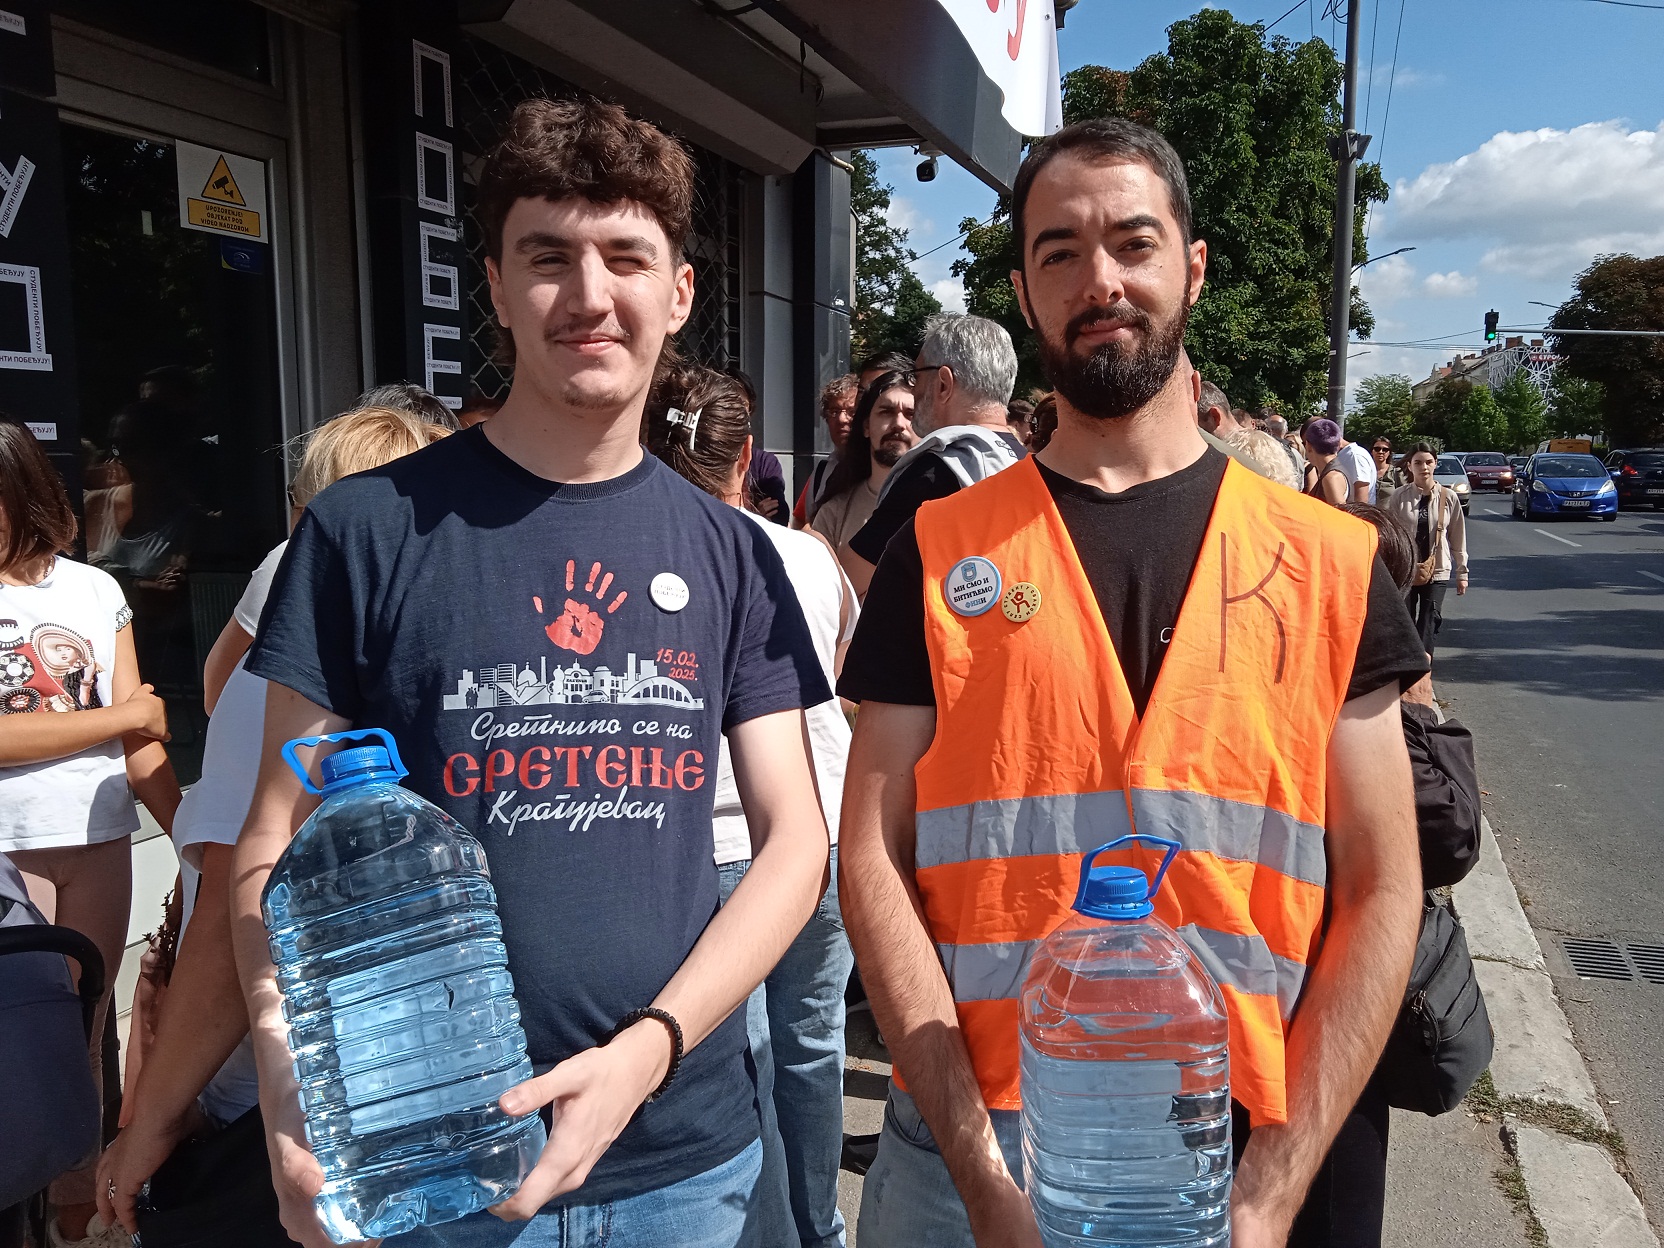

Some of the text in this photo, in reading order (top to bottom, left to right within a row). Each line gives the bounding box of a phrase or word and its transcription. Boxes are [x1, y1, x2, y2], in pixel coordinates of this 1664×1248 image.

[11, 160, 30, 199] ПОБЕЂУЈУ!
[205, 204, 243, 218] UPOZORENJE!
[206, 212, 231, 222] OBJEKAT
[200, 218, 250, 233] VIDEO NADZOROM
[30, 269, 42, 352] СТУДЕНТИ ПОБЕЂУЈУ!
[13, 356, 51, 365] ПОБЕЂУЈУ!
[953, 576, 990, 594] МИ СМО И
[953, 585, 993, 603] БИТИЋЕМО
[656, 648, 699, 668] 15.02.
[668, 667, 698, 681] 2025.
[632, 720, 660, 737] се
[666, 723, 693, 739] на
[443, 745, 705, 797] СРЕТЕЊЕ
